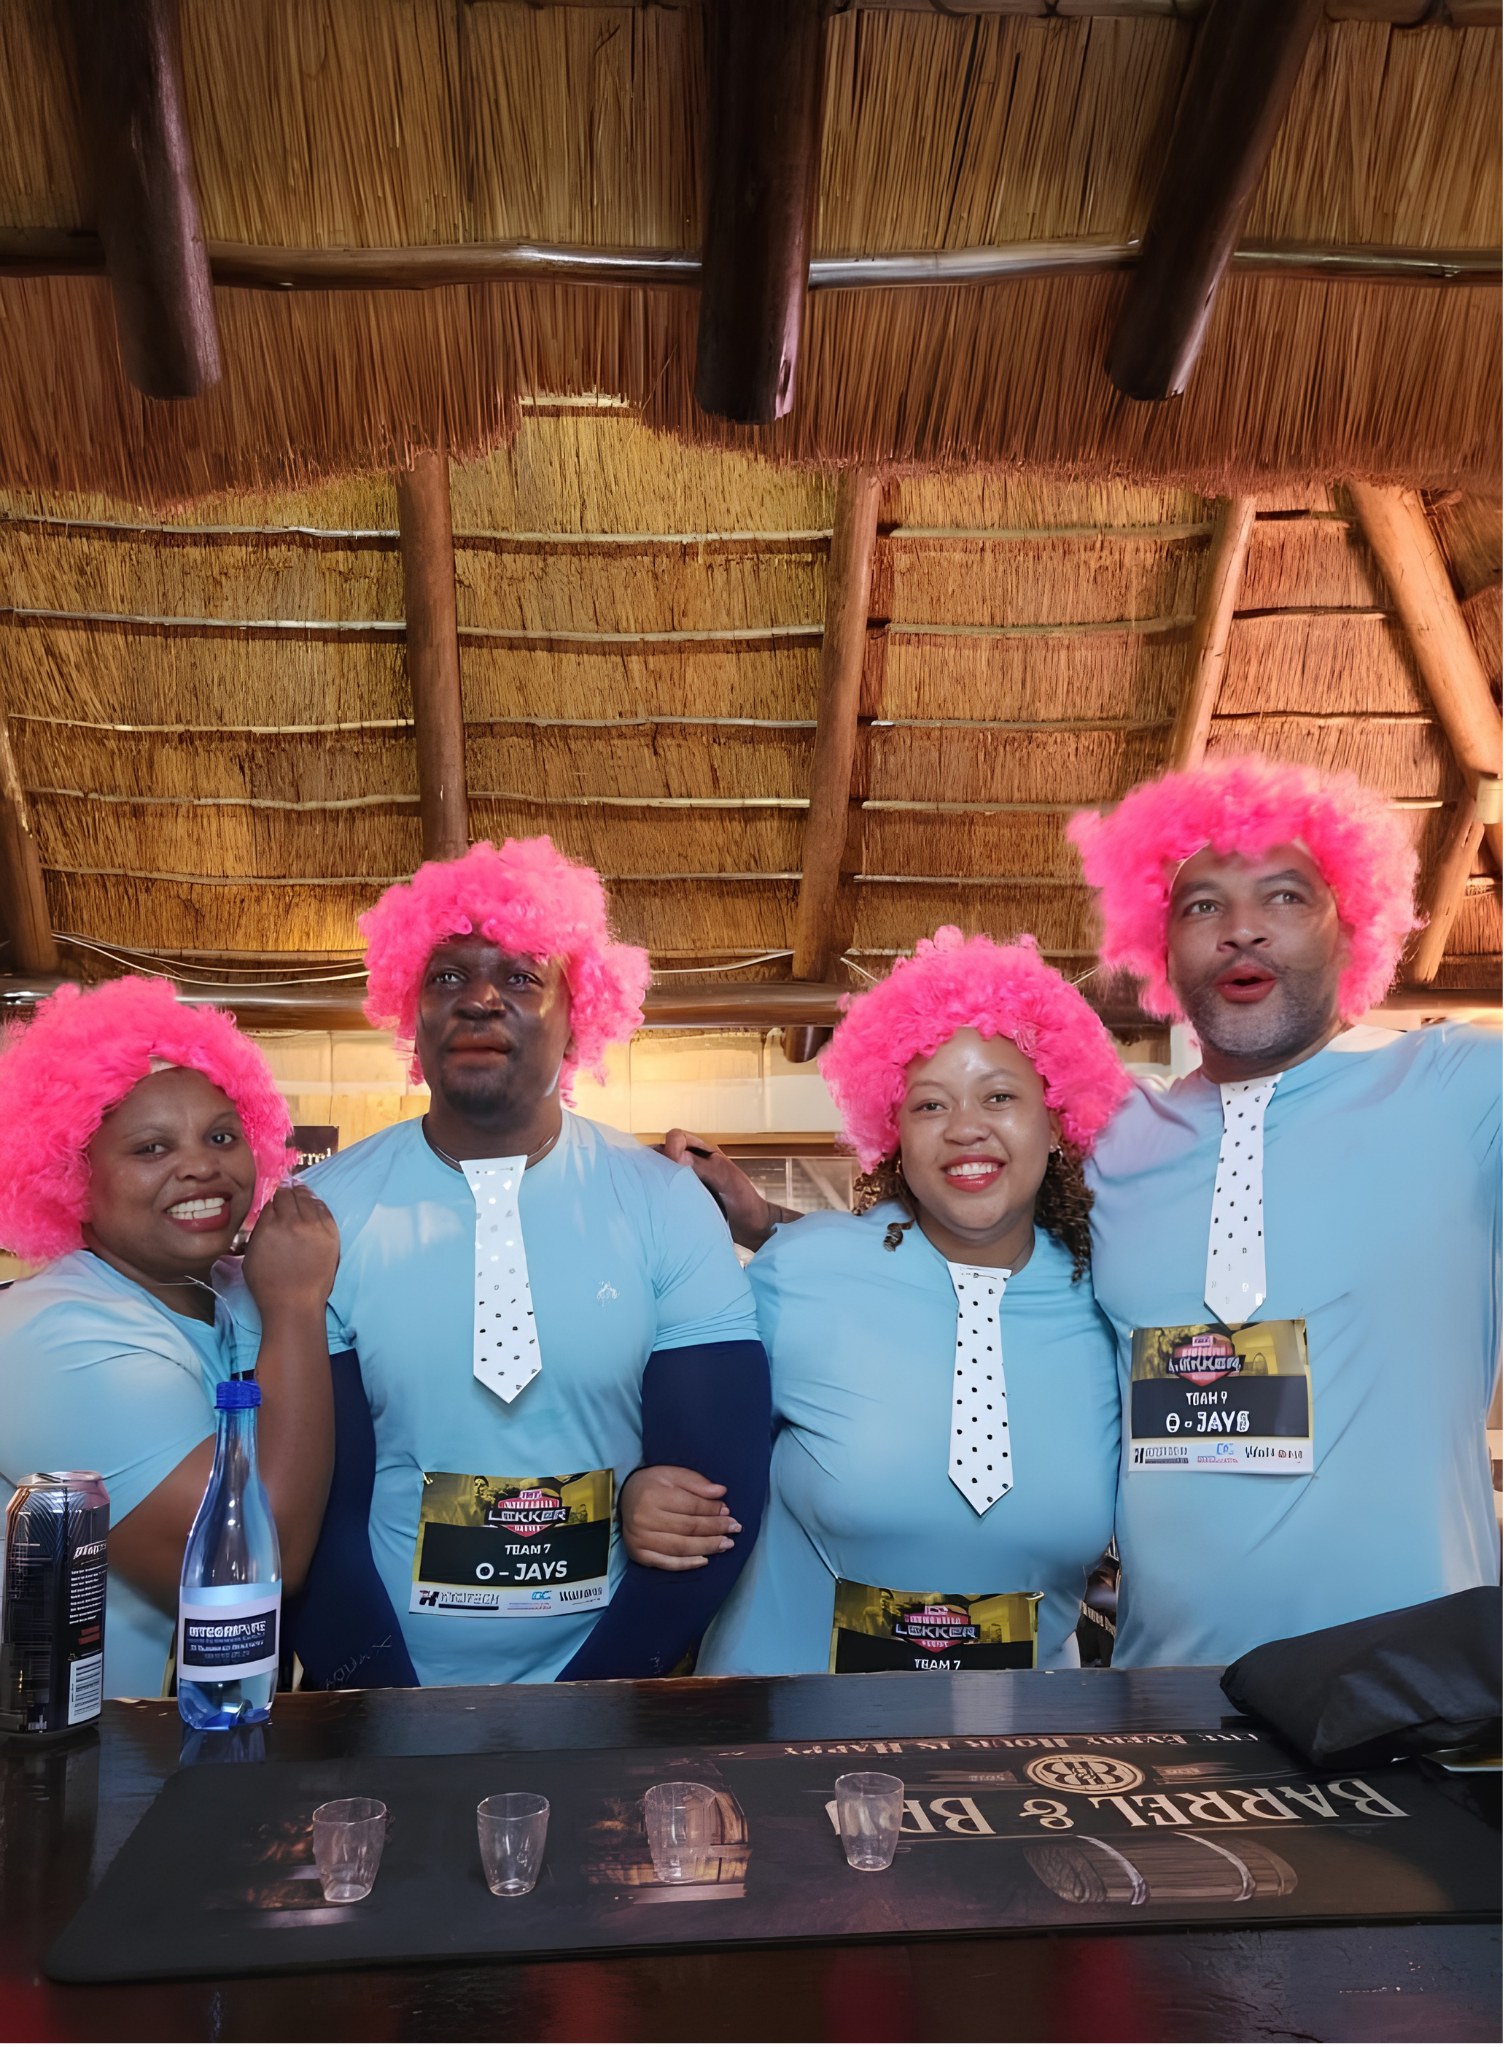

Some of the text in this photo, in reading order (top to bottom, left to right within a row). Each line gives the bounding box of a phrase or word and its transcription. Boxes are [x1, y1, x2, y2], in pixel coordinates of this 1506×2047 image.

[504, 1543, 552, 1556] TEAM 7
[475, 1562, 495, 1581] O
[513, 1560, 568, 1581] JAYS
[914, 1658, 962, 1671] TEAM 7
[1087, 1777, 1412, 1828] BARREL
[1018, 1798, 1075, 1830] &
